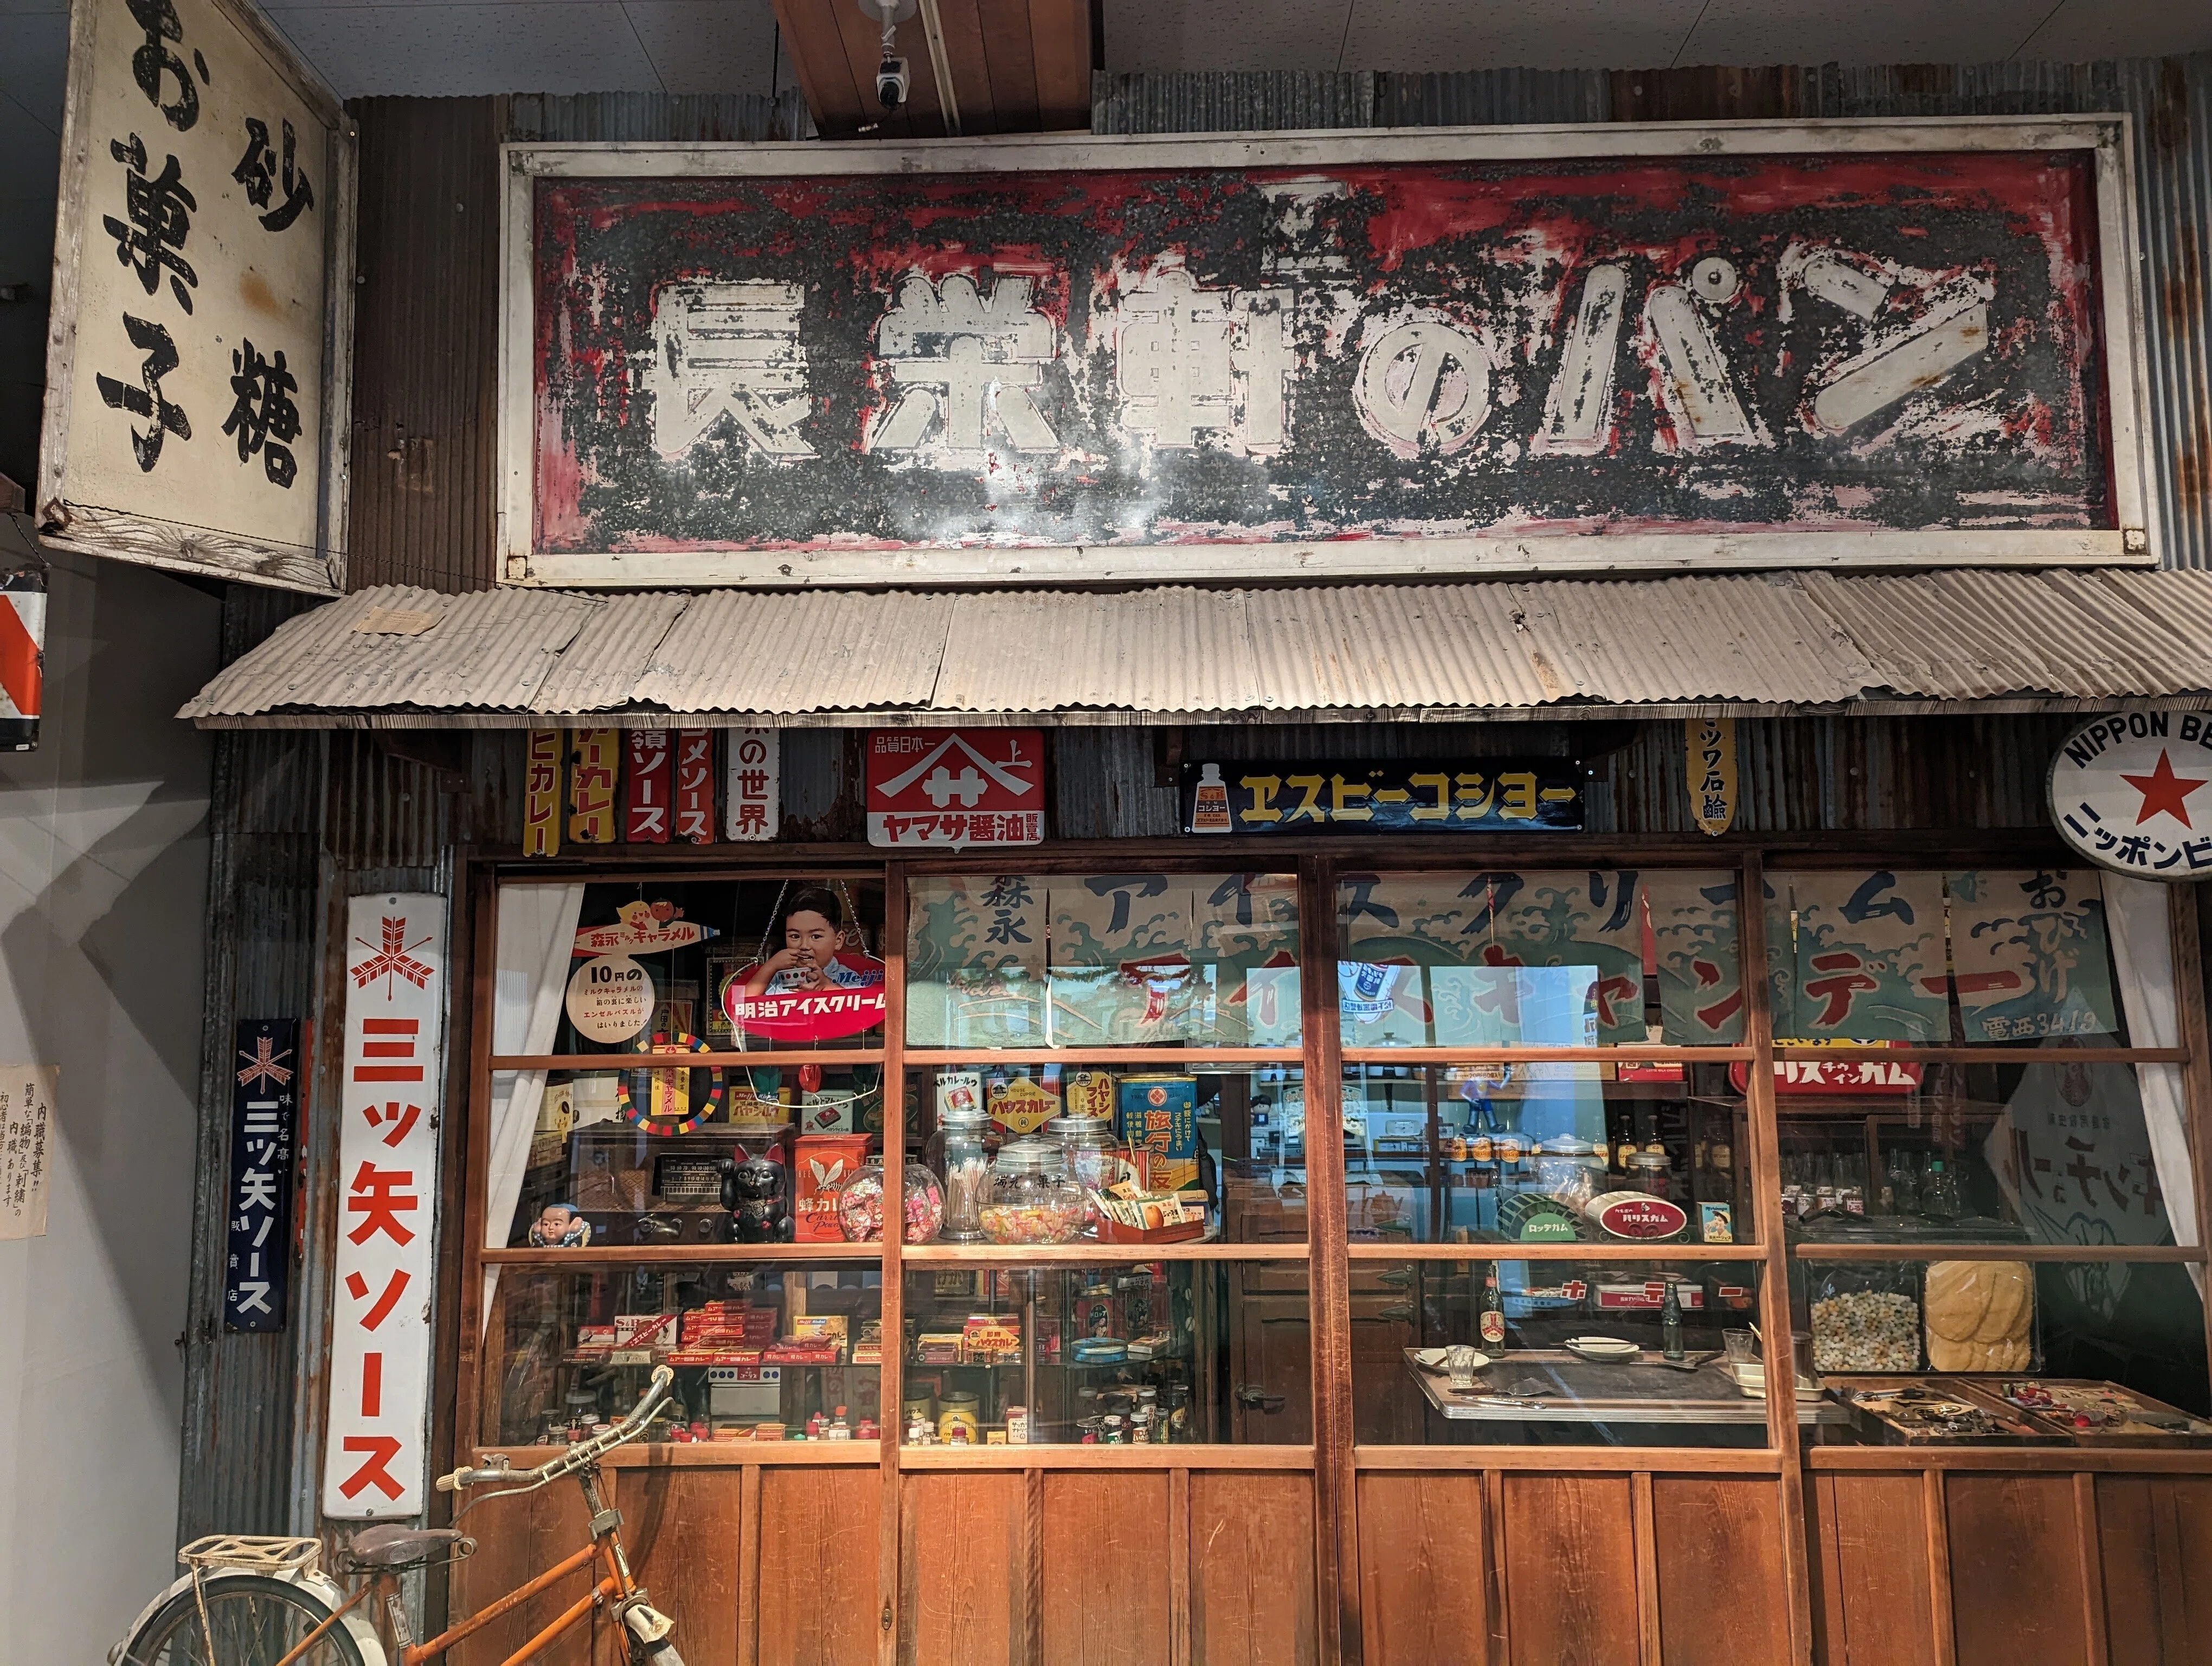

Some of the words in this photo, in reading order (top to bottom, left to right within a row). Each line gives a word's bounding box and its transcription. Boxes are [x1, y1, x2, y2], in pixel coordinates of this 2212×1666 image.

[96, 0, 210, 473] お菓子
[221, 117, 314, 489] 砂糖
[875, 736, 936, 754] 品質日本一
[2063, 710, 2169, 770] NIPPON
[591, 965, 643, 984] 10円の
[832, 970, 884, 987] Meiji
[991, 1099, 1056, 1115] ハウスカレー
[1086, 1087, 1098, 1118] ライス
[1098, 1078, 1110, 1114] ハヤシ
[236, 1100, 280, 1315] 三ツ矢ソース
[1622, 1214, 1669, 1222] ハリスガム
[1528, 1223, 1568, 1233] ロッテガム
[338, 1018, 425, 1502] 三ツ矢ソース
[616, 1318, 639, 1327] S&B
